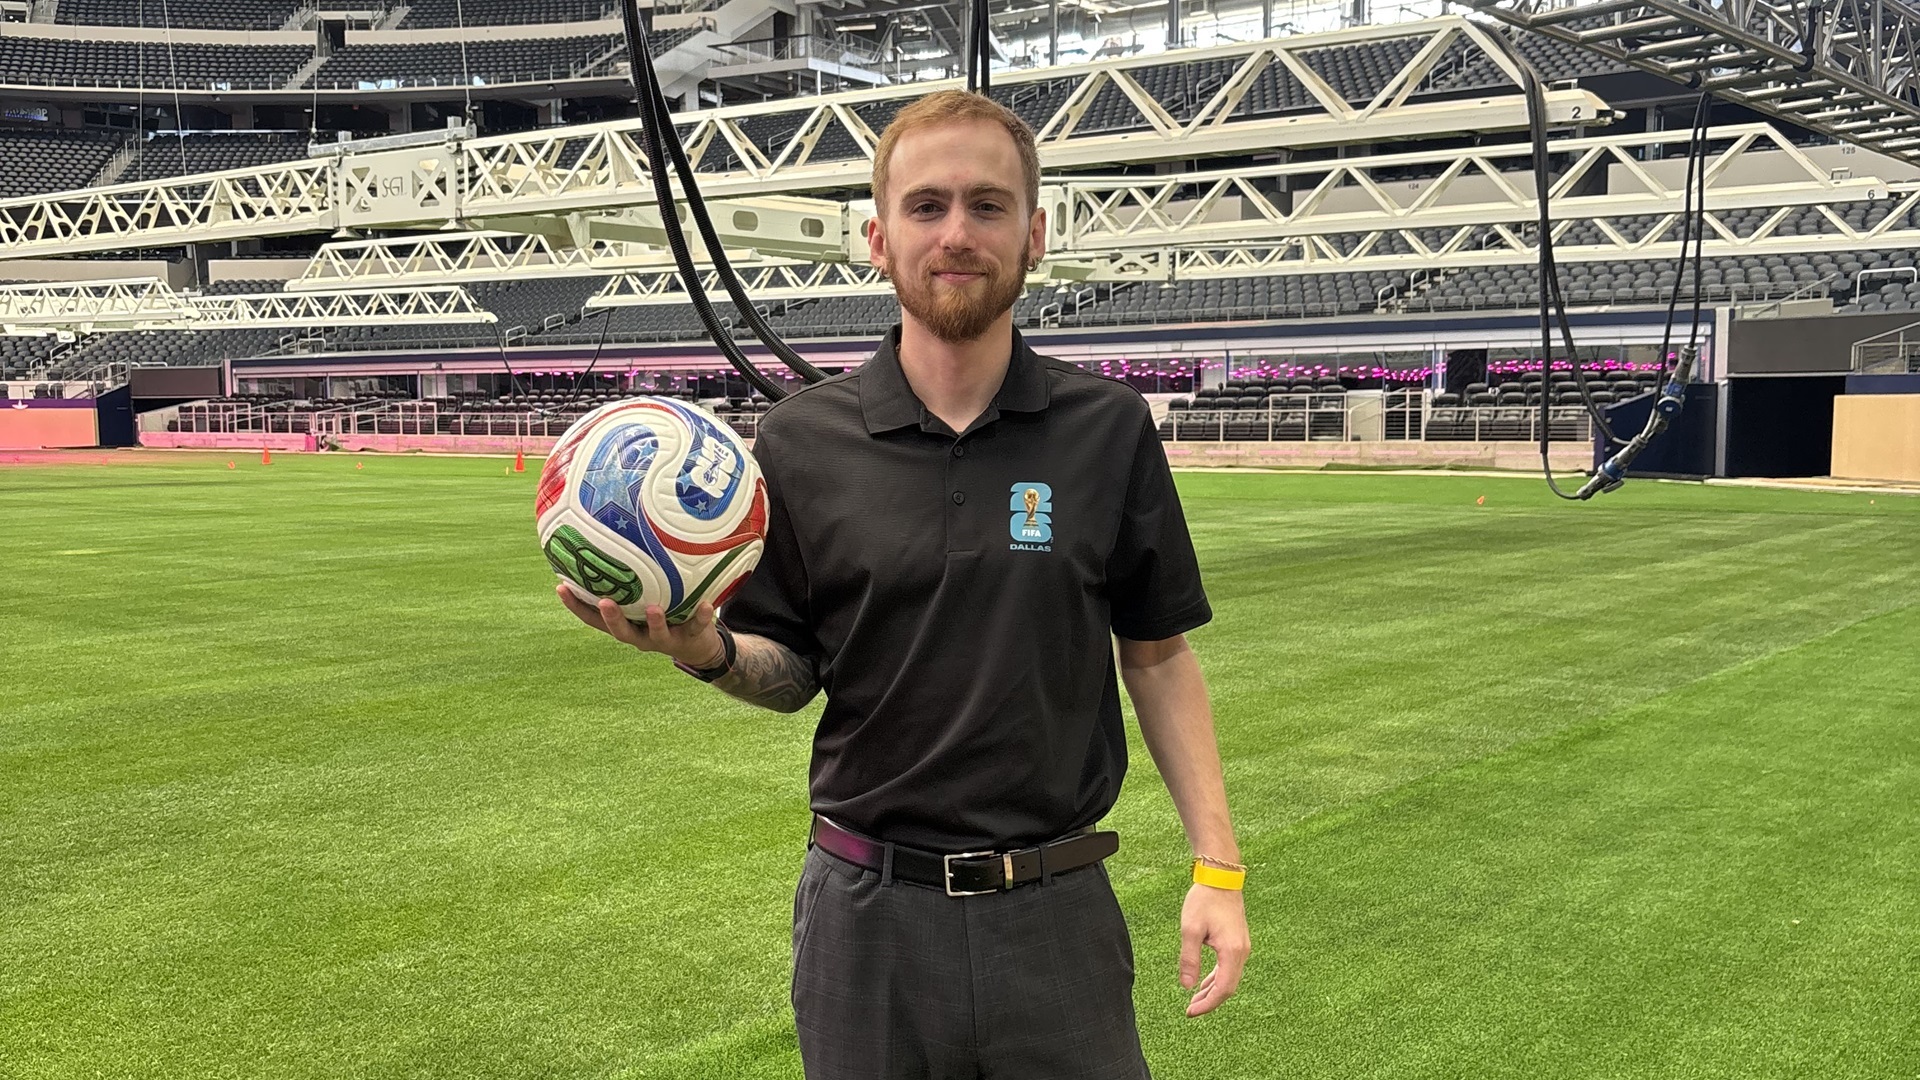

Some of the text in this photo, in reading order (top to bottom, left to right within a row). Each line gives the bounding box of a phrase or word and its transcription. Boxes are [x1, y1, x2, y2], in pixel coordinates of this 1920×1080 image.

[1572, 106, 1581, 119] 2
[1867, 189, 1875, 200] 6
[1021, 529, 1042, 537] FIFA
[1009, 543, 1052, 553] DALLAS
